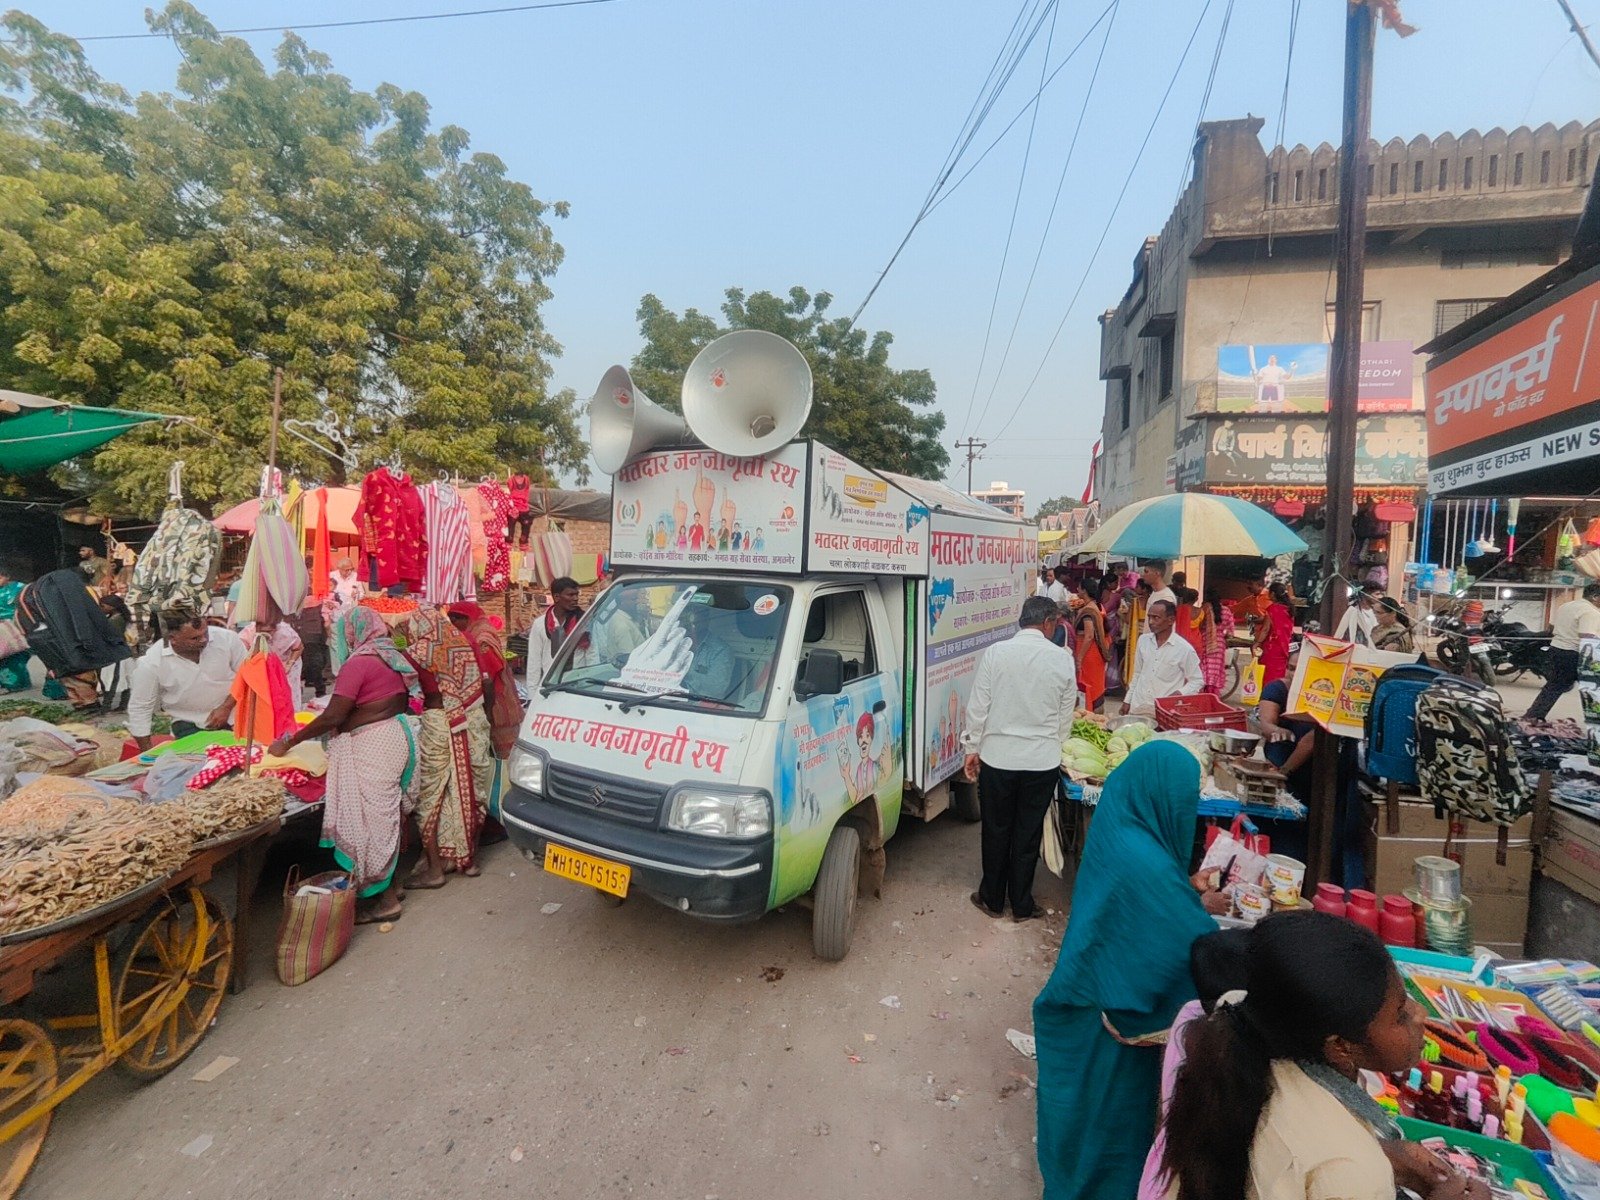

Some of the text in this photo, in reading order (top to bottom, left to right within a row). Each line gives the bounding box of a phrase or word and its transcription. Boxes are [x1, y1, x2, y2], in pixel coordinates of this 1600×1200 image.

[1358, 369, 1402, 378] EEDOM
[1542, 432, 1582, 458] NEW
[618, 454, 670, 484] मतदार
[770, 460, 800, 489] रथ
[1448, 462, 1473, 486] शुभम
[814, 532, 920, 559] मतदार जनजागृती रथ
[931, 527, 1036, 574] मतदार जनजागृती रथ
[844, 558, 871, 570] लोकशाही
[531, 713, 730, 774] मतदार जनजागृती रथ
